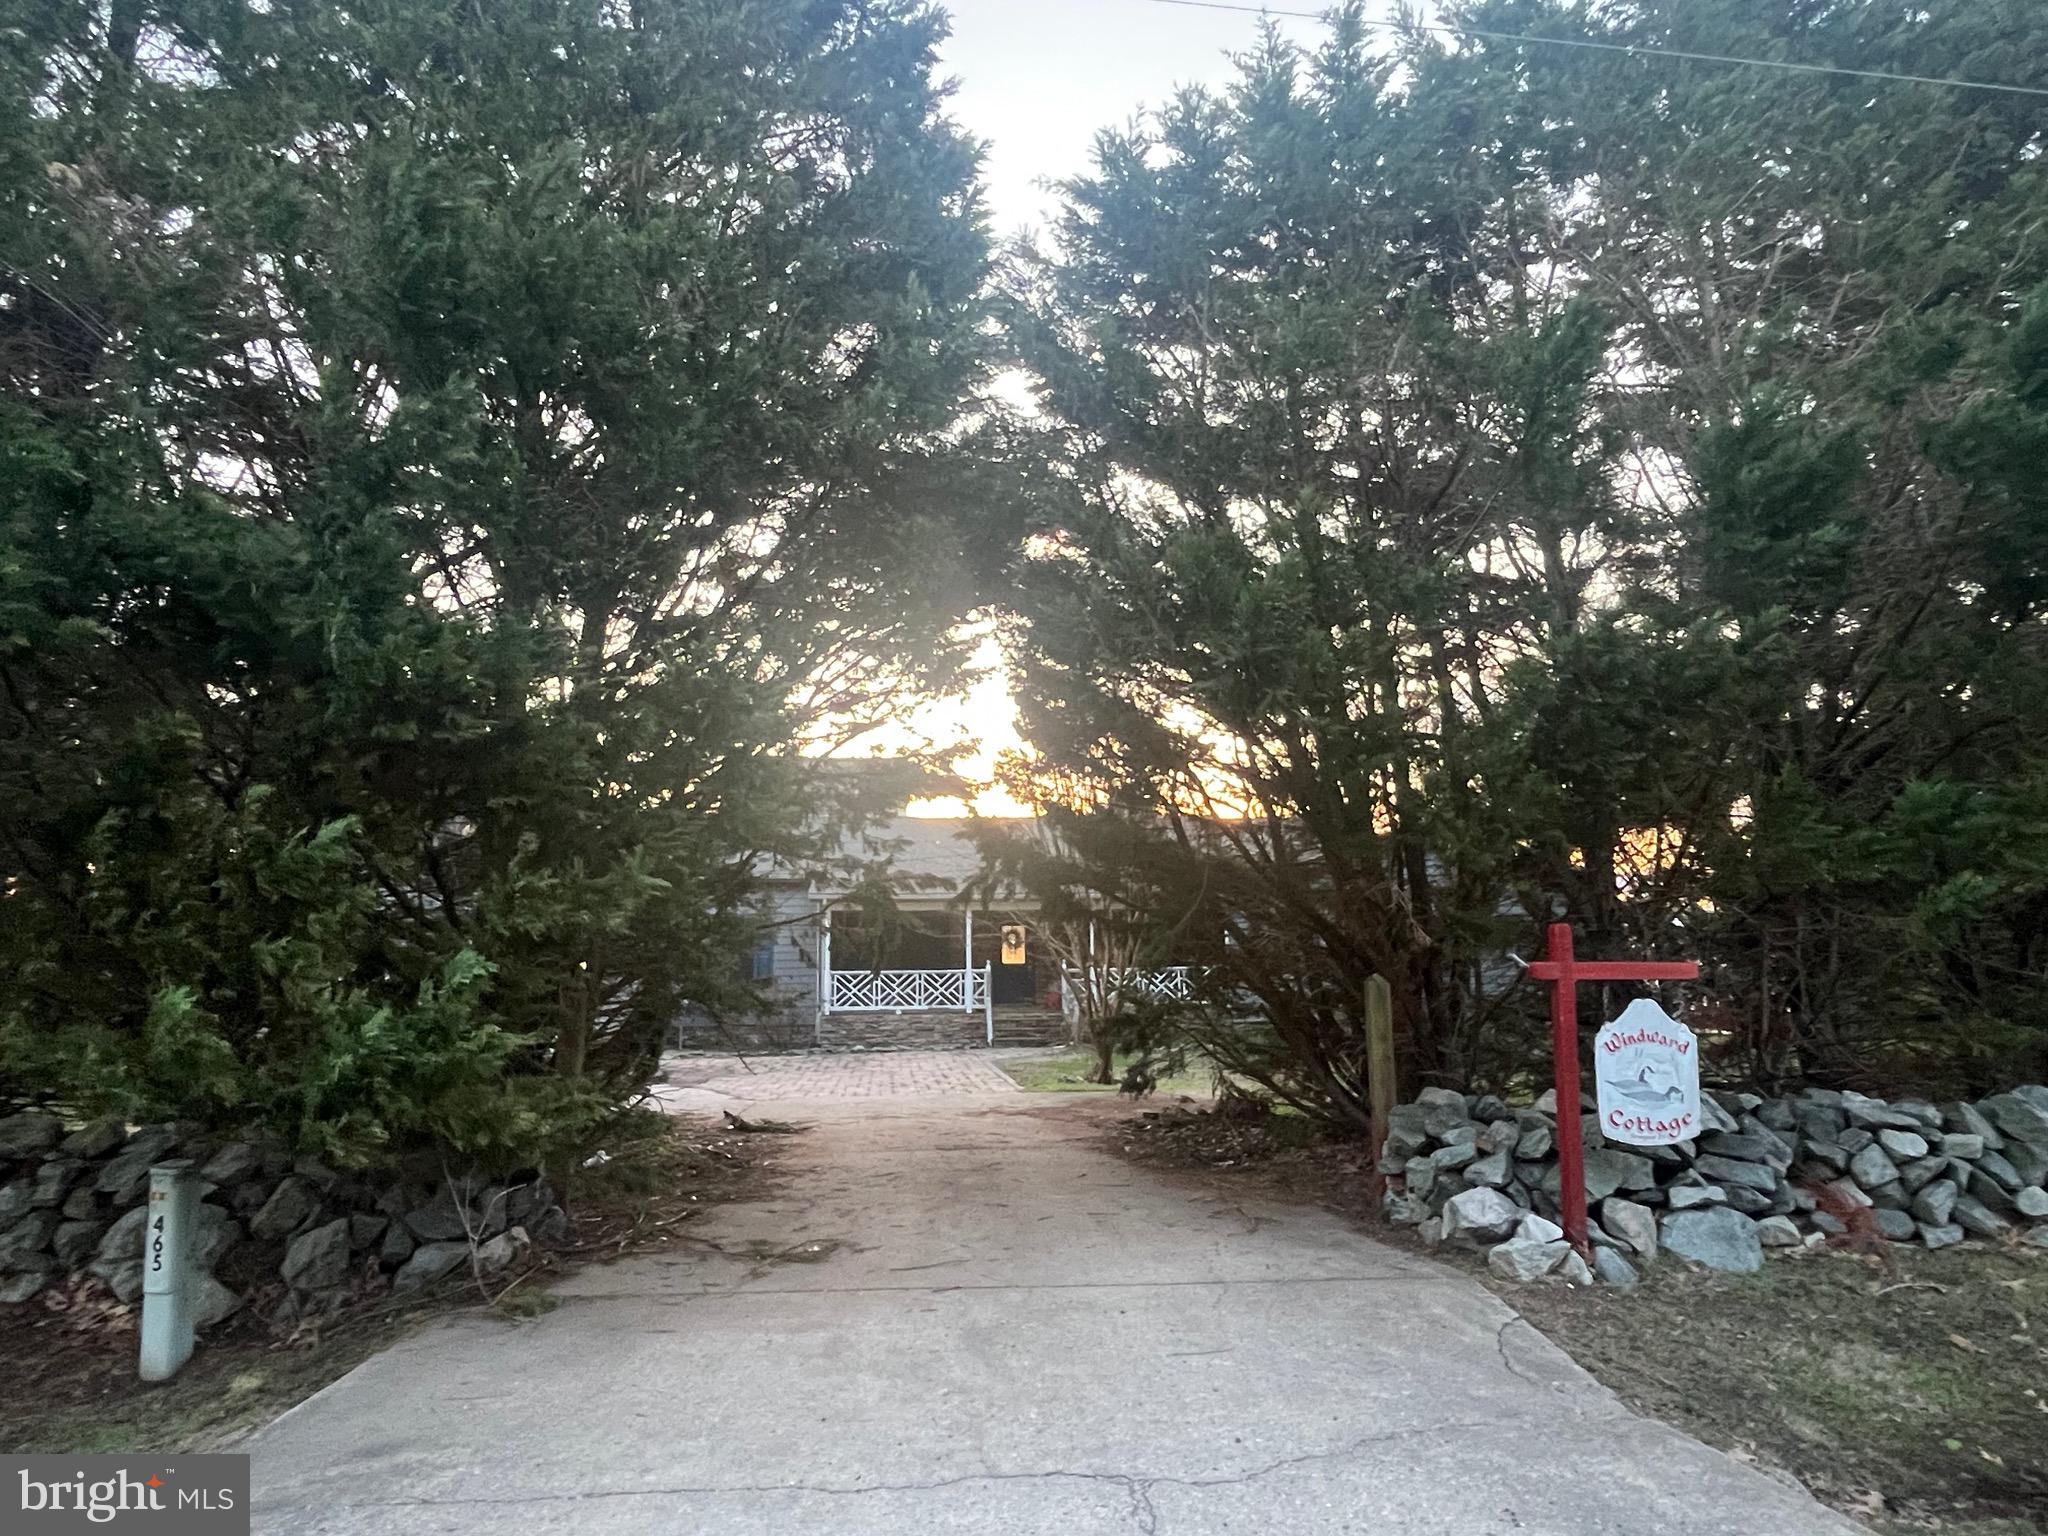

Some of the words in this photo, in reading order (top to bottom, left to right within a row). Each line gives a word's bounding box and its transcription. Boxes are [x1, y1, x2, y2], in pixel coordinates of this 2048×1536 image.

[1603, 1028, 1690, 1055] Windward
[1609, 1109, 1692, 1137] Cottage
[152, 1215, 164, 1272] 465
